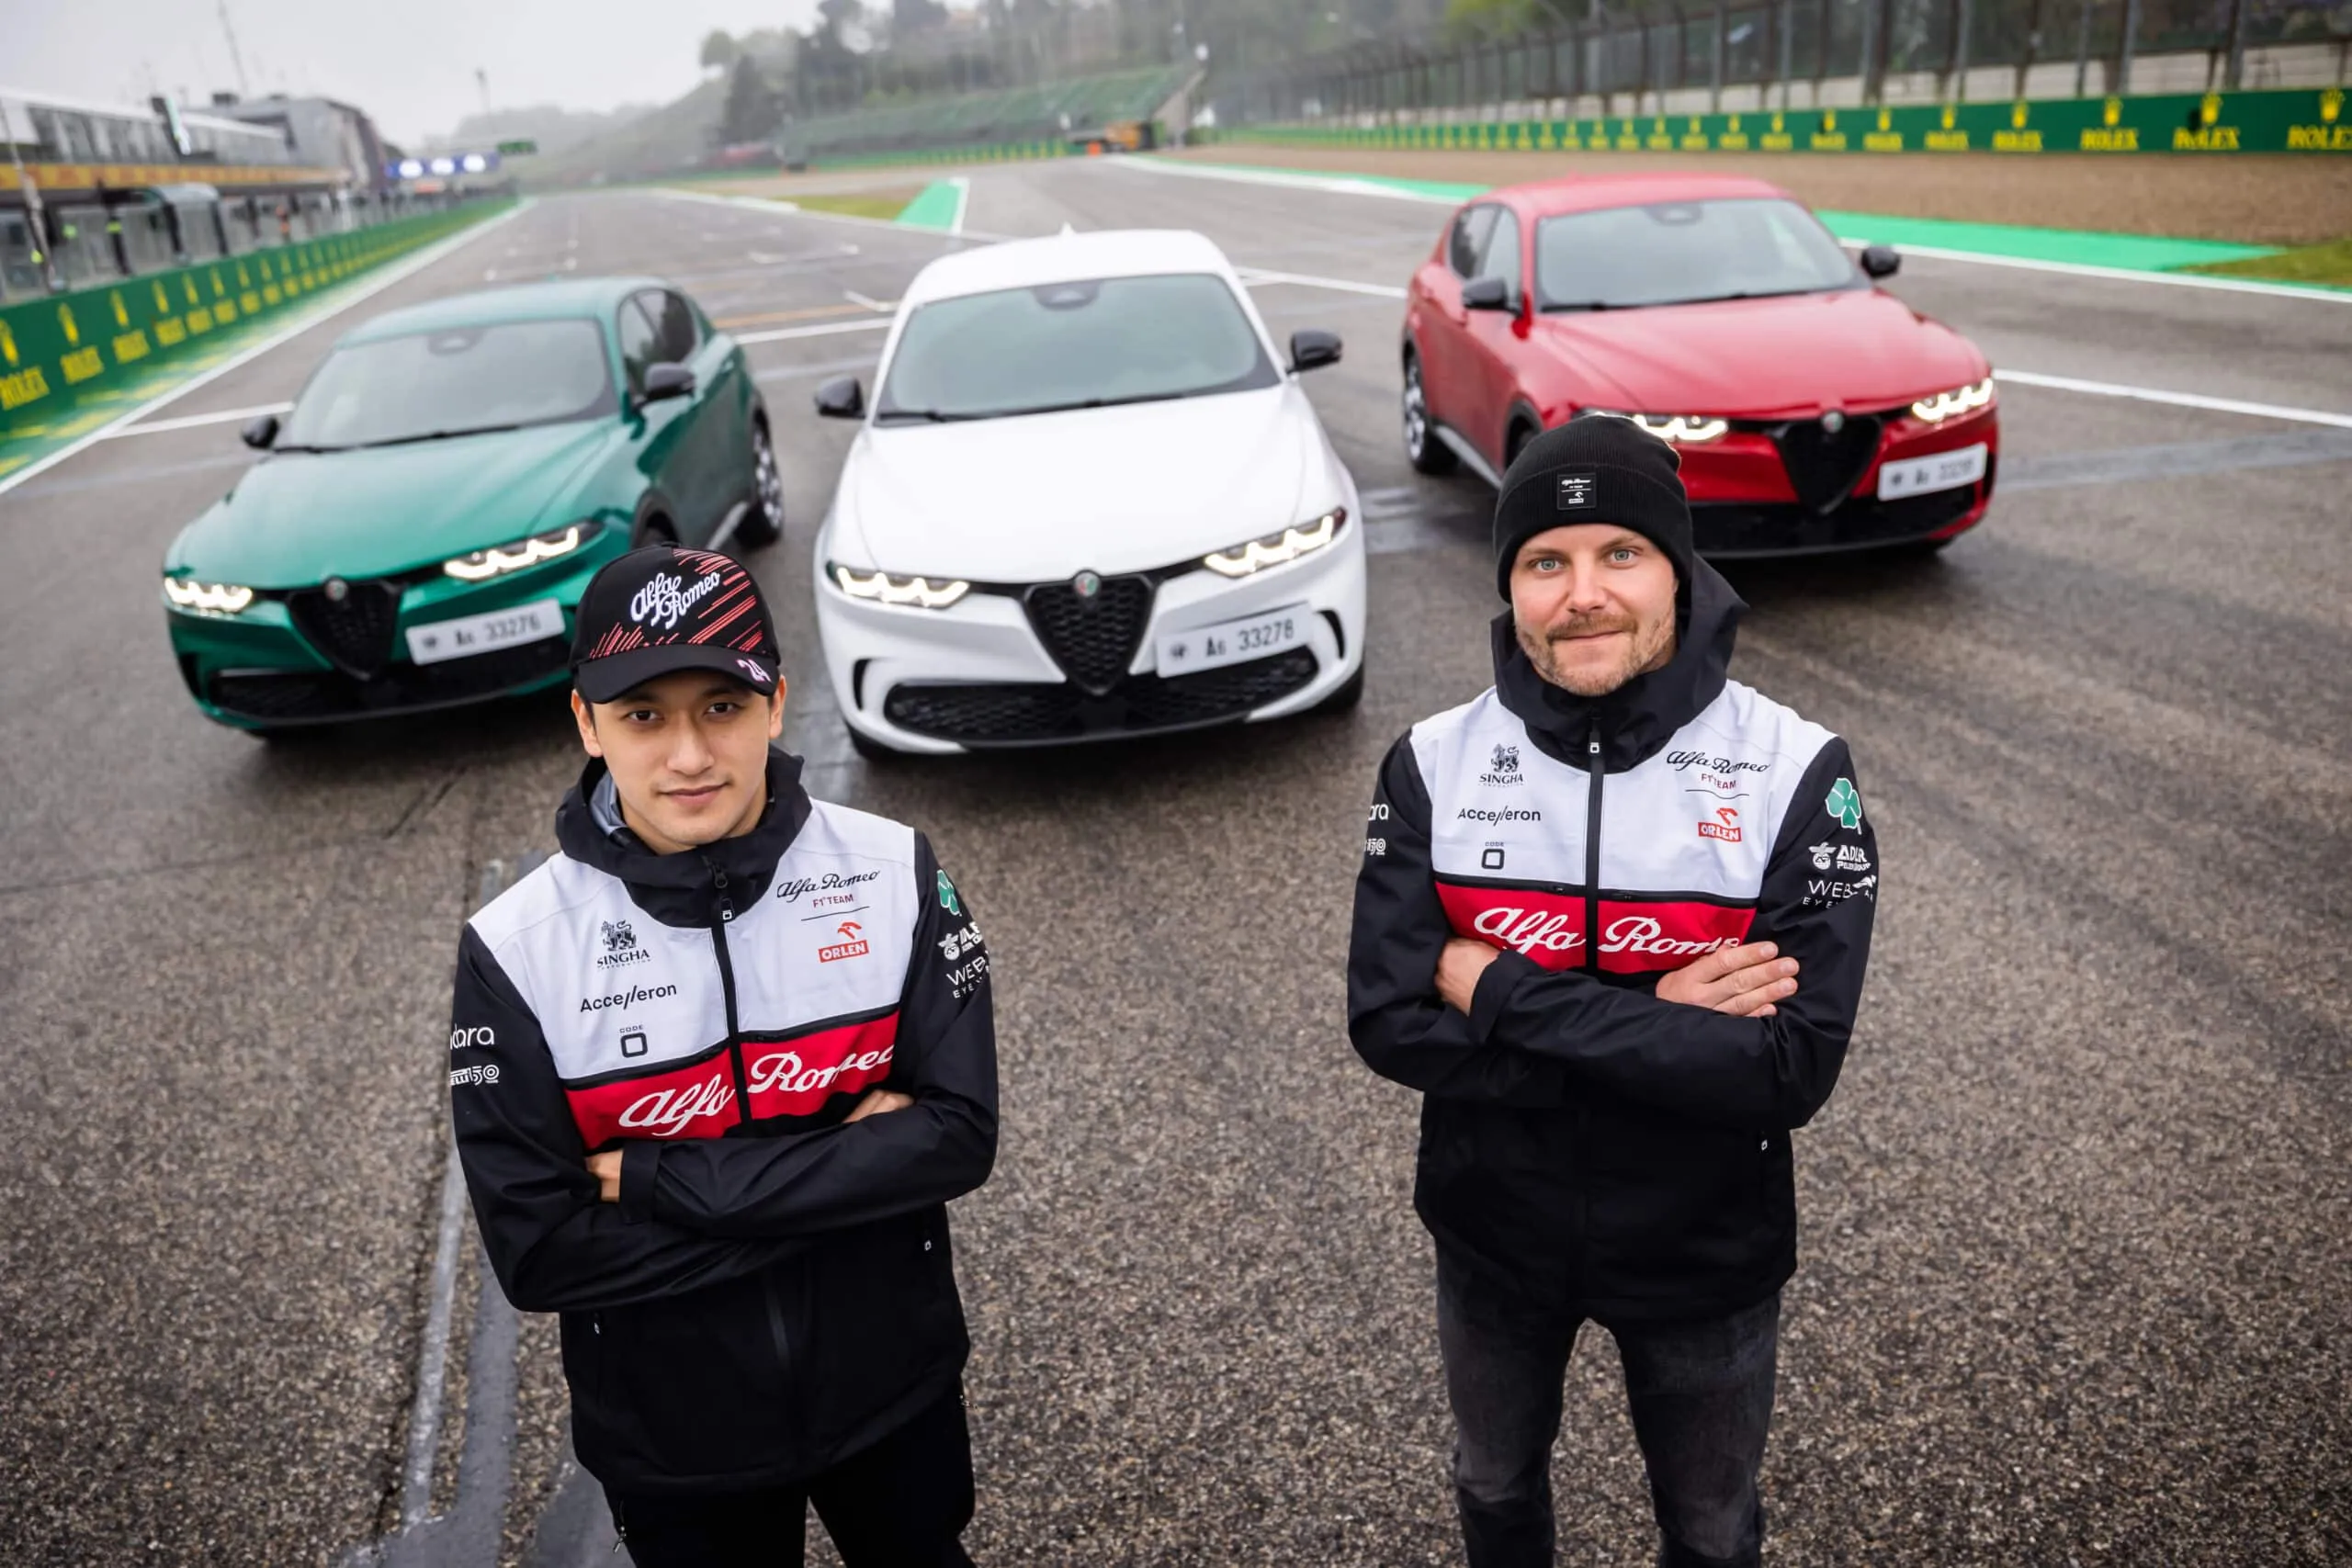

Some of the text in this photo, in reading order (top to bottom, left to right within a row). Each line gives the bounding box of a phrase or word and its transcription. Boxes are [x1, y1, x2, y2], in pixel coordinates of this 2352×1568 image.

[630, 571, 683, 626] Alfa
[658, 571, 720, 629] Romeo
[1667, 750, 1771, 773] Alfa Romeo
[1479, 773, 1523, 784] SINGHA
[1700, 825, 1739, 840] ORLEN
[776, 870, 880, 903] Alfa Romeo
[826, 894, 854, 905] TEAM
[1474, 907, 1587, 954] Alfa
[596, 948, 650, 968] SINGHA
[820, 942, 865, 960] ORLEN
[619, 1023, 644, 1033] CODE
[618, 1073, 736, 1137] Alfa
